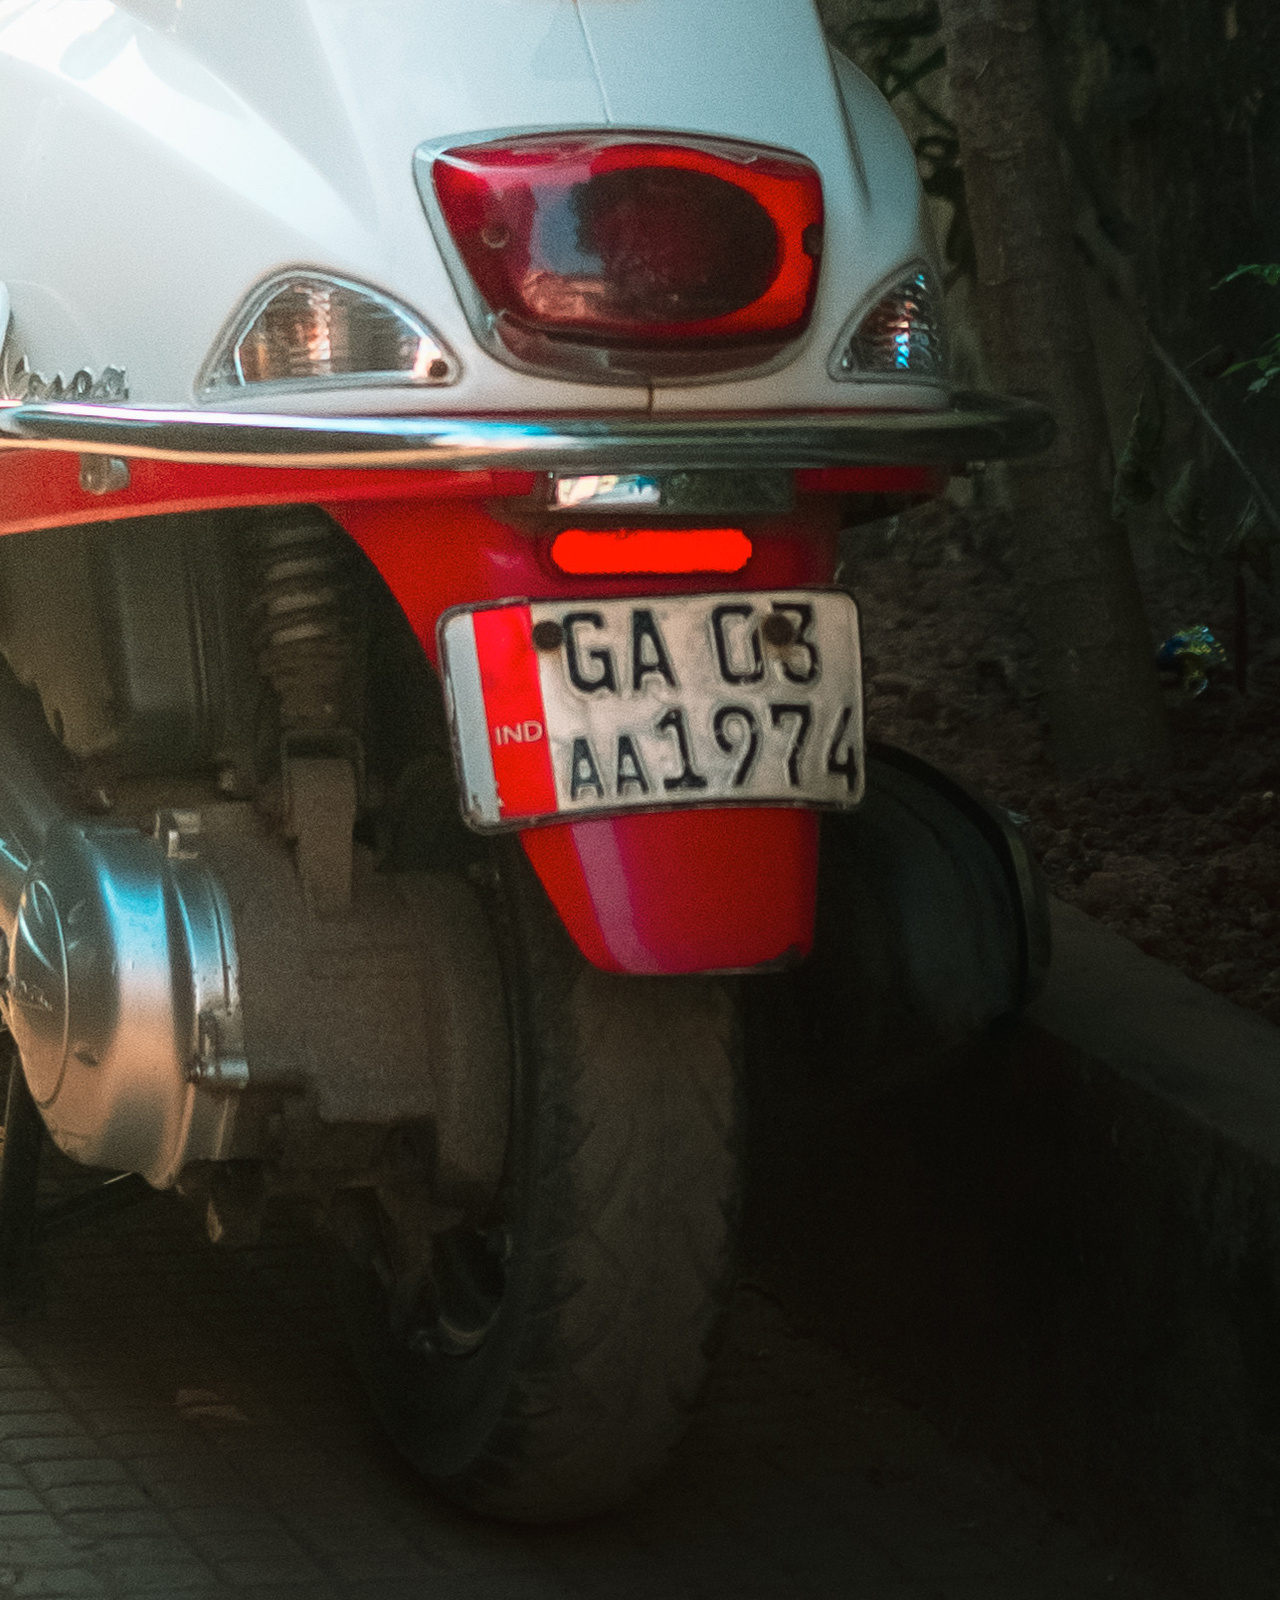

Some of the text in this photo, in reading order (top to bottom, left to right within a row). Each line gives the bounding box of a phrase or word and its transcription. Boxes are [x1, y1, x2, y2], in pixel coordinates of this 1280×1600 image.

[562, 603, 819, 693] GA 03
[494, 719, 544, 747] IND
